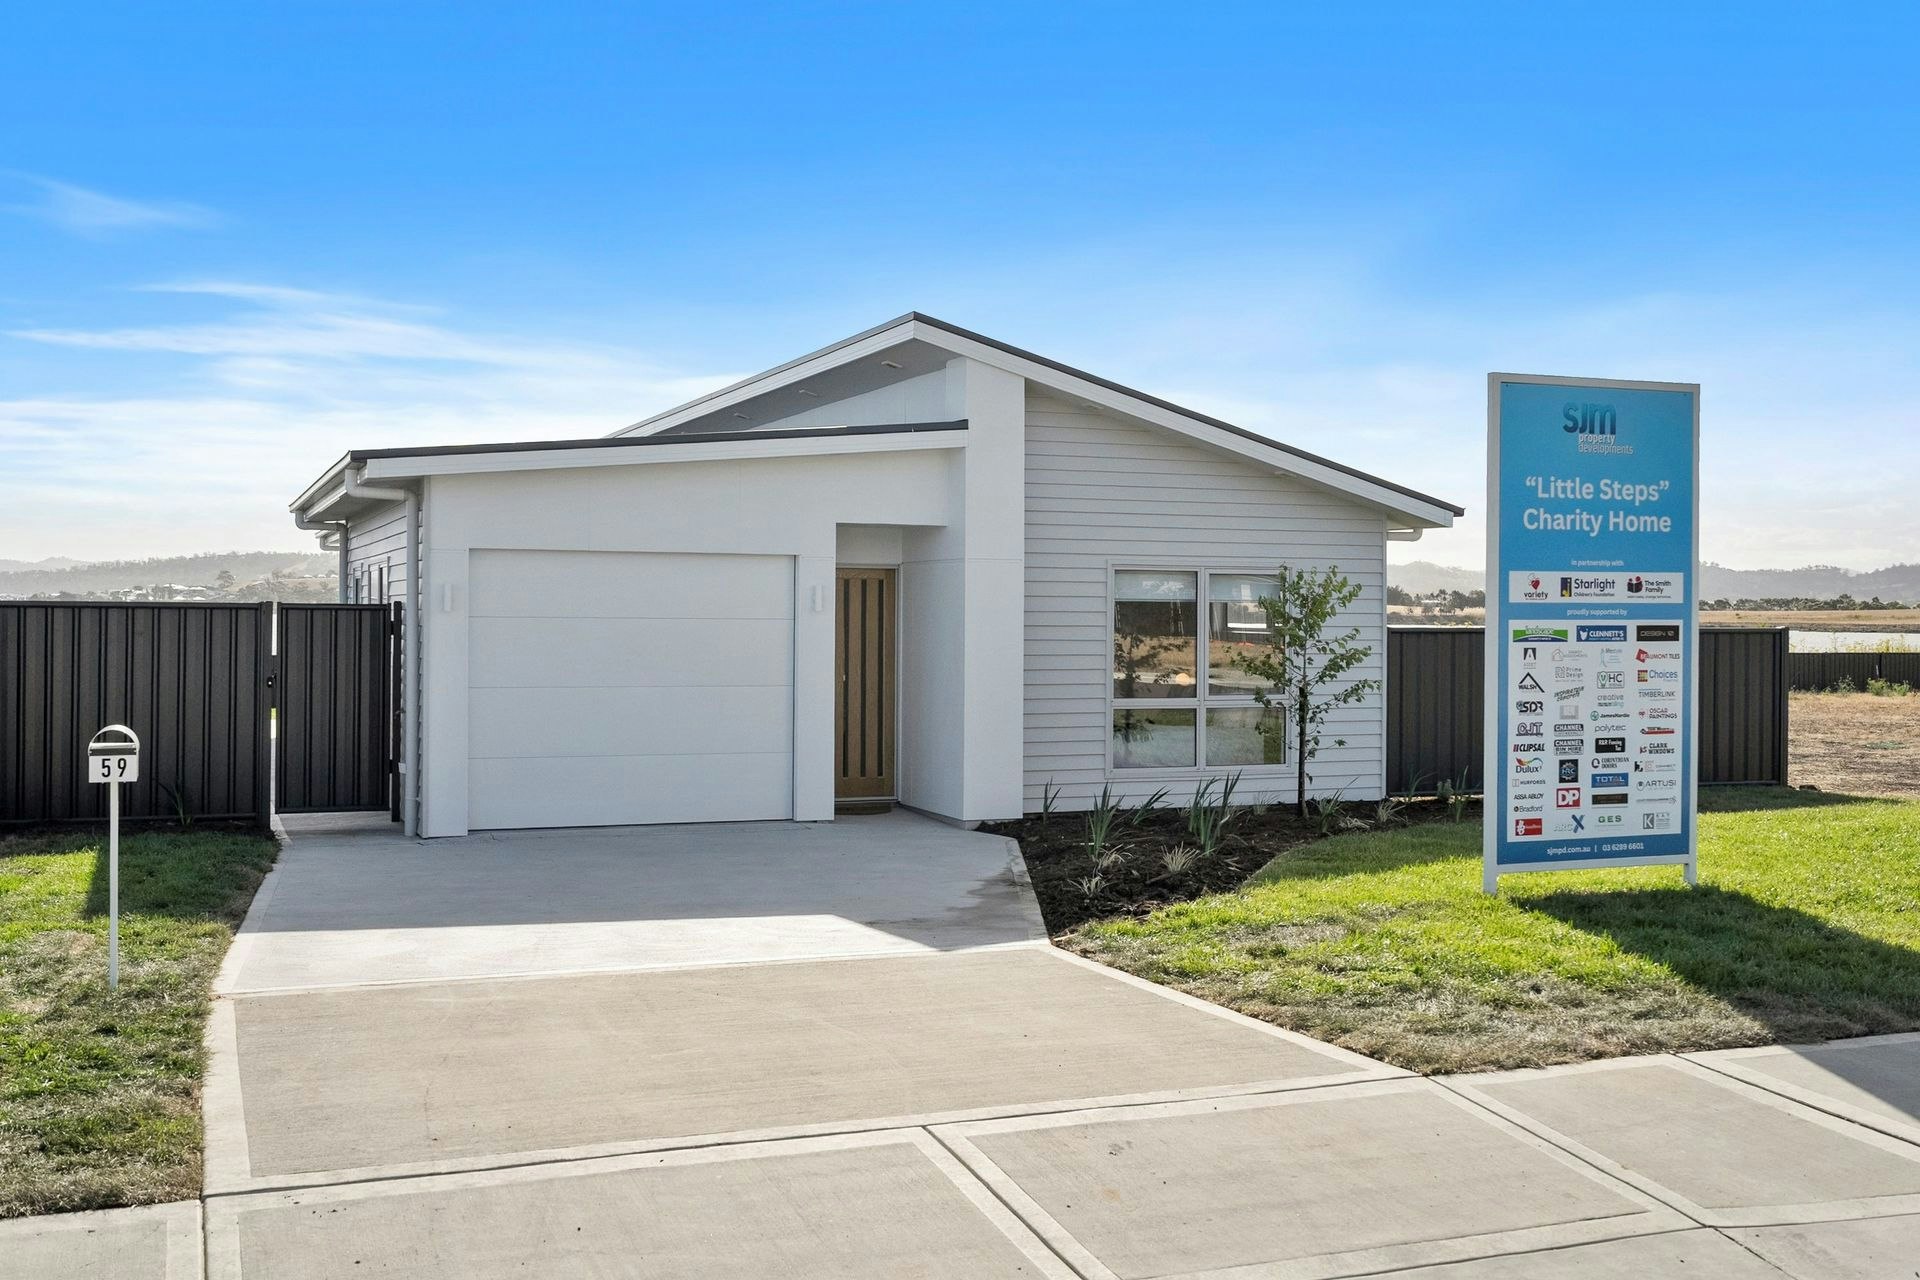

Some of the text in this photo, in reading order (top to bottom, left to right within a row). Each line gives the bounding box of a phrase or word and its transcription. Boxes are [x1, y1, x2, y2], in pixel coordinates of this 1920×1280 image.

[1578, 433, 1616, 445] property
[1578, 443, 1634, 455] developments
[1523, 508, 1671, 537] Charity Home
[1578, 559, 1610, 567] partnership
[1574, 578, 1616, 592] Starlight
[1645, 586, 1664, 594] Family
[1524, 591, 1549, 600] variety
[1567, 608, 1628, 617] proudly supported by
[1649, 669, 1678, 679] Choices
[1594, 724, 1627, 733] polytec
[1519, 743, 1545, 752] CLIPSAL
[1645, 780, 1677, 788] ARTUSI
[1557, 790, 1580, 806] DP
[1598, 815, 1622, 824] GES
